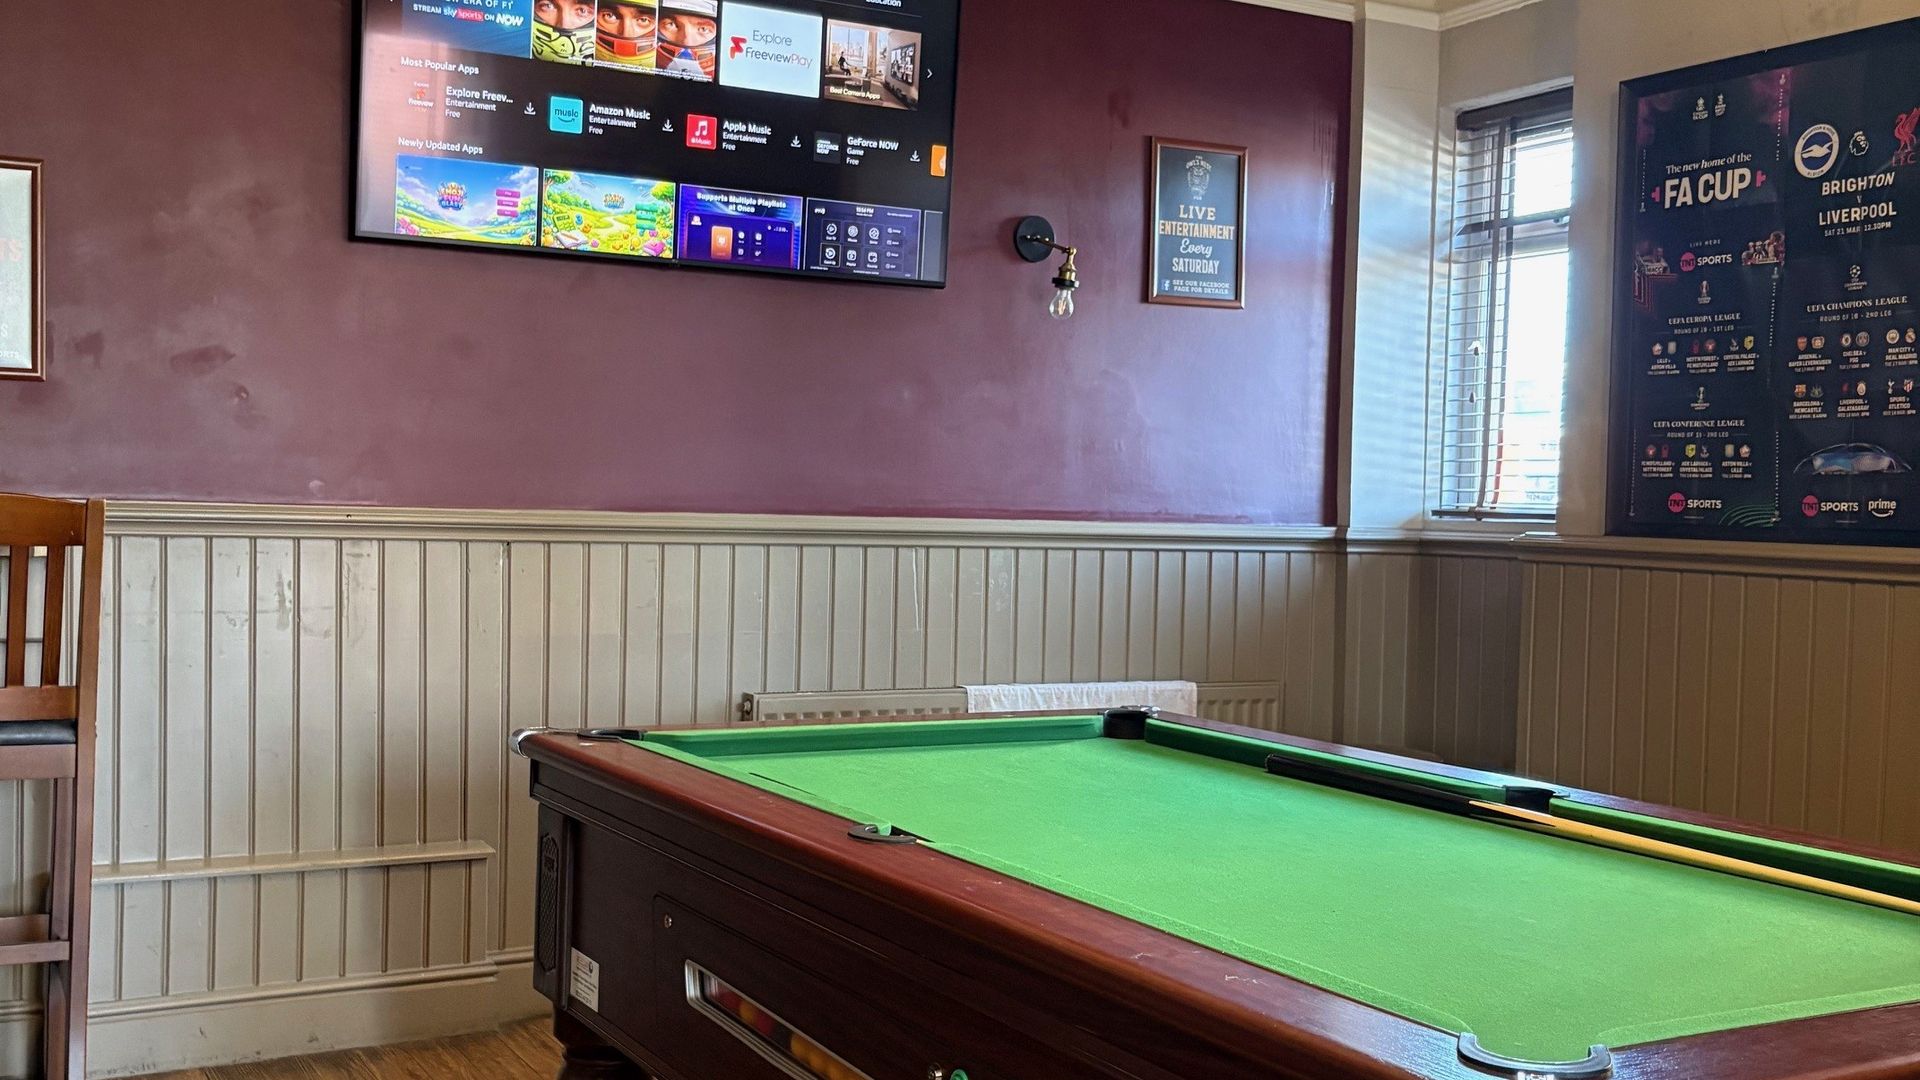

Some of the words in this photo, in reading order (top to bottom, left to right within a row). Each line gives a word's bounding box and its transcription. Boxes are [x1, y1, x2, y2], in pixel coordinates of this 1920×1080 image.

[413, 4, 441, 14] STREAM
[444, 7, 457, 18] sky
[458, 9, 483, 20] sports
[496, 14, 524, 26] NOW
[753, 30, 792, 46] Explore
[401, 56, 422, 68] Most
[425, 60, 456, 72] Popular
[458, 64, 480, 76] Apps
[446, 86, 480, 99] Explore
[446, 98, 496, 112] Entertainment
[445, 108, 460, 118] Free
[554, 108, 579, 118] music
[589, 104, 624, 117] Amazon
[625, 108, 651, 120] Music
[588, 115, 637, 128] Entertainment
[723, 120, 746, 132] Apple
[748, 124, 772, 136] Music
[588, 126, 604, 135] Free
[722, 132, 768, 144] Entertainment
[847, 136, 878, 148] GeForce
[878, 140, 899, 150] NOW
[398, 137, 424, 150] Newly
[426, 140, 460, 154] Updated
[462, 144, 484, 155] Apps
[722, 142, 736, 151] Free
[846, 148, 864, 156] Game
[846, 157, 860, 166] Free
[1666, 164, 1682, 174] The
[1682, 162, 1701, 172] new
[1702, 160, 1726, 168] home
[1726, 154, 1736, 164] of
[1737, 152, 1752, 162] the
[1664, 176, 1694, 208] FA
[1698, 167, 1752, 203] CUP
[1822, 172, 1896, 196] BRIGHTON
[696, 192, 728, 202] Supports
[728, 194, 756, 205] Multiple
[736, 204, 756, 213] Once
[1179, 204, 1216, 220] LIVE
[1818, 202, 1896, 226] LIVERPOOL
[1159, 220, 1234, 240] ENTERTAINMENT
[1846, 226, 1860, 234] MAR
[1180, 238, 1212, 258] Every
[1172, 258, 1220, 274] SATURDAY
[1697, 254, 1732, 266] SPORTS
[1806, 304, 1826, 312] UEFA
[1826, 300, 1872, 312] CHAMPIONS
[1875, 296, 1908, 306] LEAGUE
[1686, 316, 1712, 324] EUROPA
[1687, 500, 1722, 508] SPORTS
[1820, 502, 1859, 512] SPORTS
[1868, 498, 1896, 510] prime
